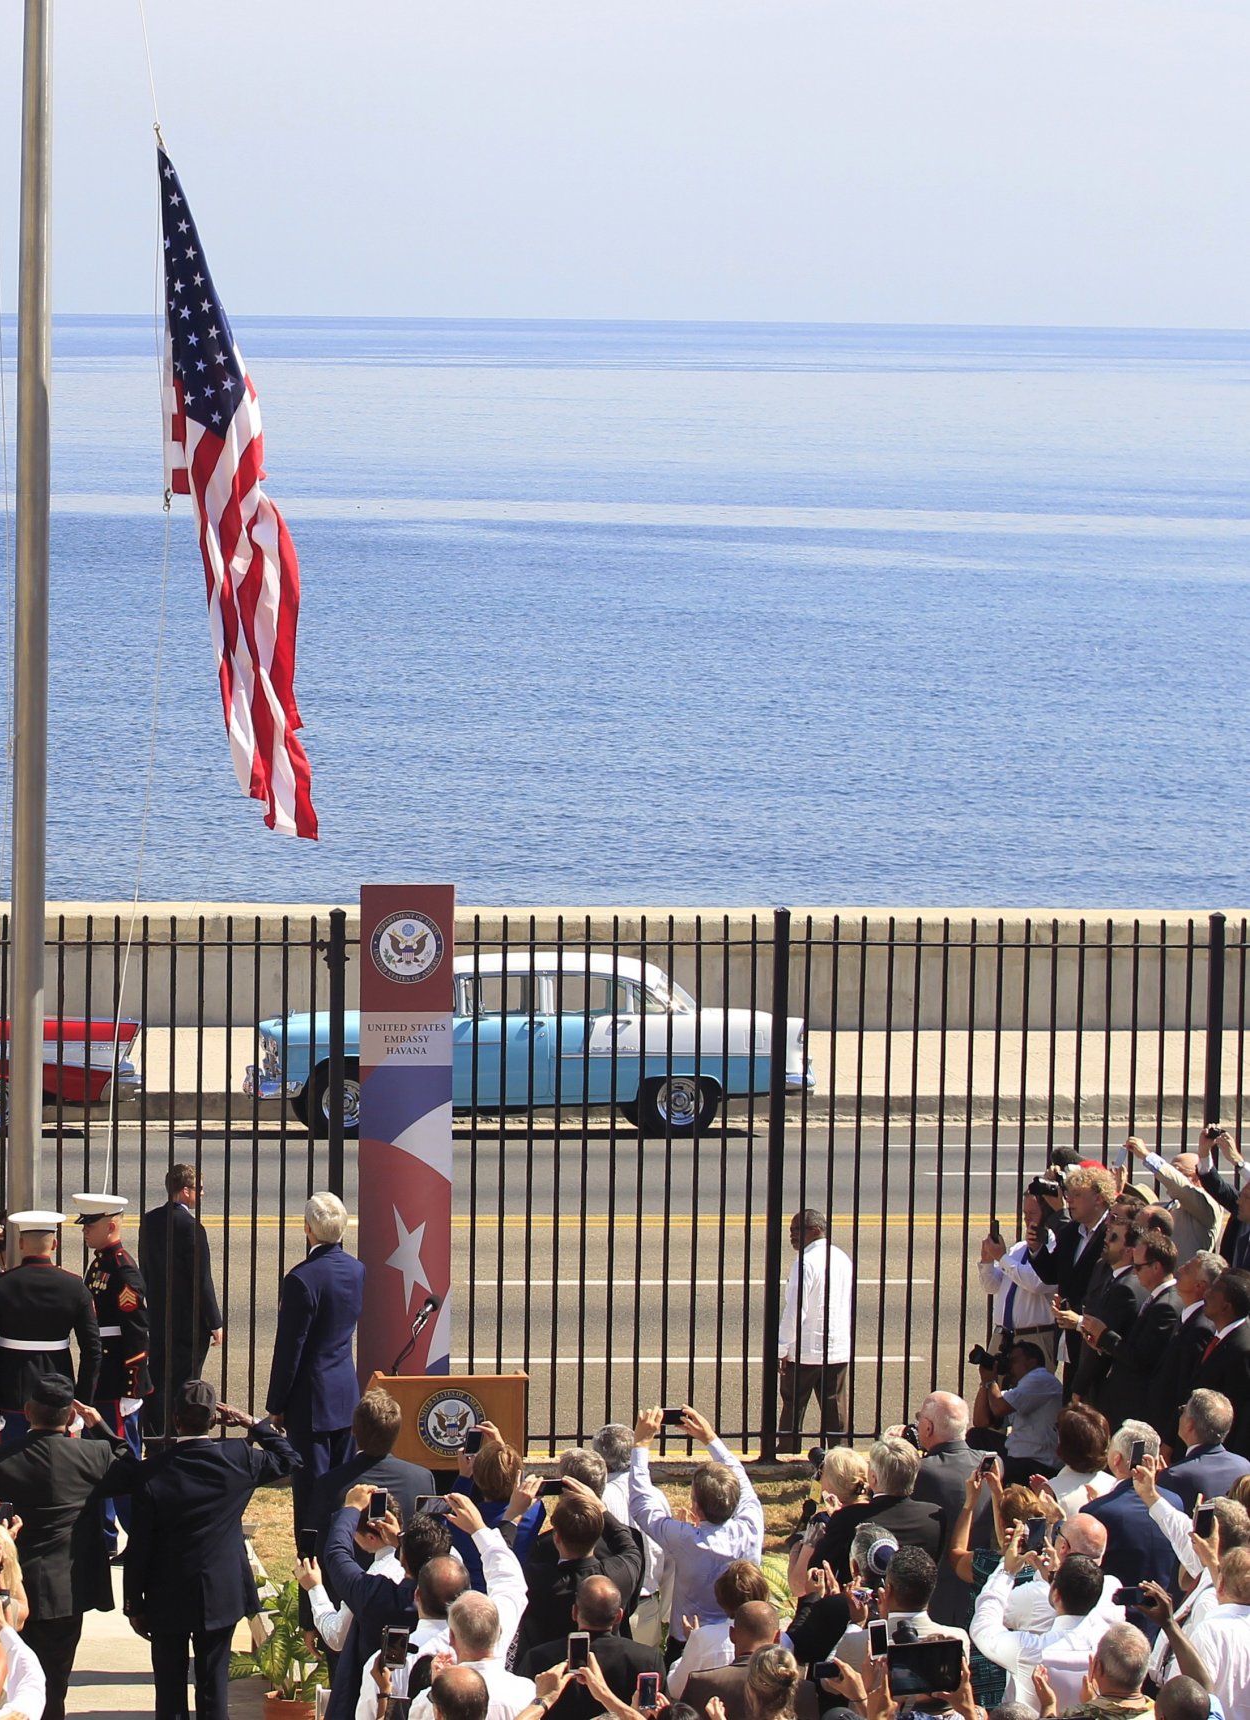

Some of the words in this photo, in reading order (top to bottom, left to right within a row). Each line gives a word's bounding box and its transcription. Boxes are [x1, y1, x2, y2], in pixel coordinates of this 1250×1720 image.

[376, 913, 416, 936] DEPARTMENT
[425, 918, 439, 937] STATE
[373, 949, 388, 973] UNITED
[388, 971, 410, 982] STATES
[422, 950, 442, 979] AMERICA
[367, 1023, 408, 1032] UNITED
[410, 1023, 446, 1032] STATES
[384, 1035, 430, 1043] EMBASSY
[386, 1046, 427, 1055] HAVANA
[419, 1400, 433, 1423] UNITED
[432, 1391, 455, 1401] STATES
[430, 1445, 457, 1455] EMBASSY
